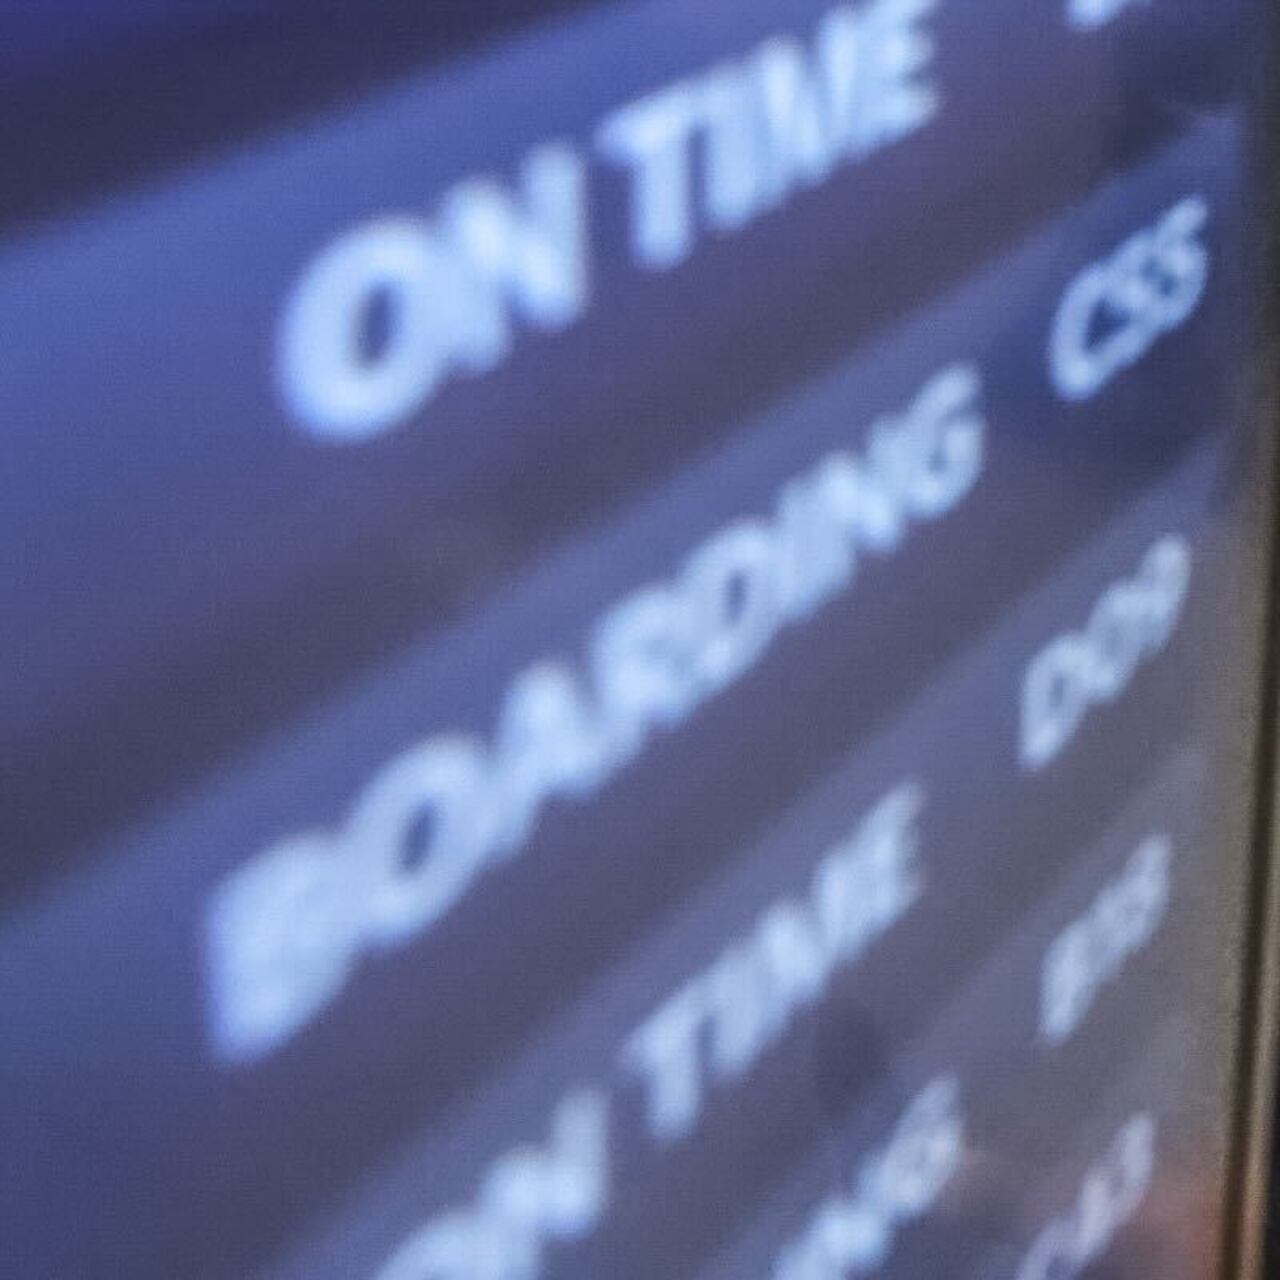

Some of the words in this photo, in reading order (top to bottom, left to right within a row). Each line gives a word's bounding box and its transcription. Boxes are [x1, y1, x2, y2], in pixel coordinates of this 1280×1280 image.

[275, 141, 592, 444] ON
[211, 365, 988, 1063] BOARDING
[622, 782, 928, 1140] TIME
